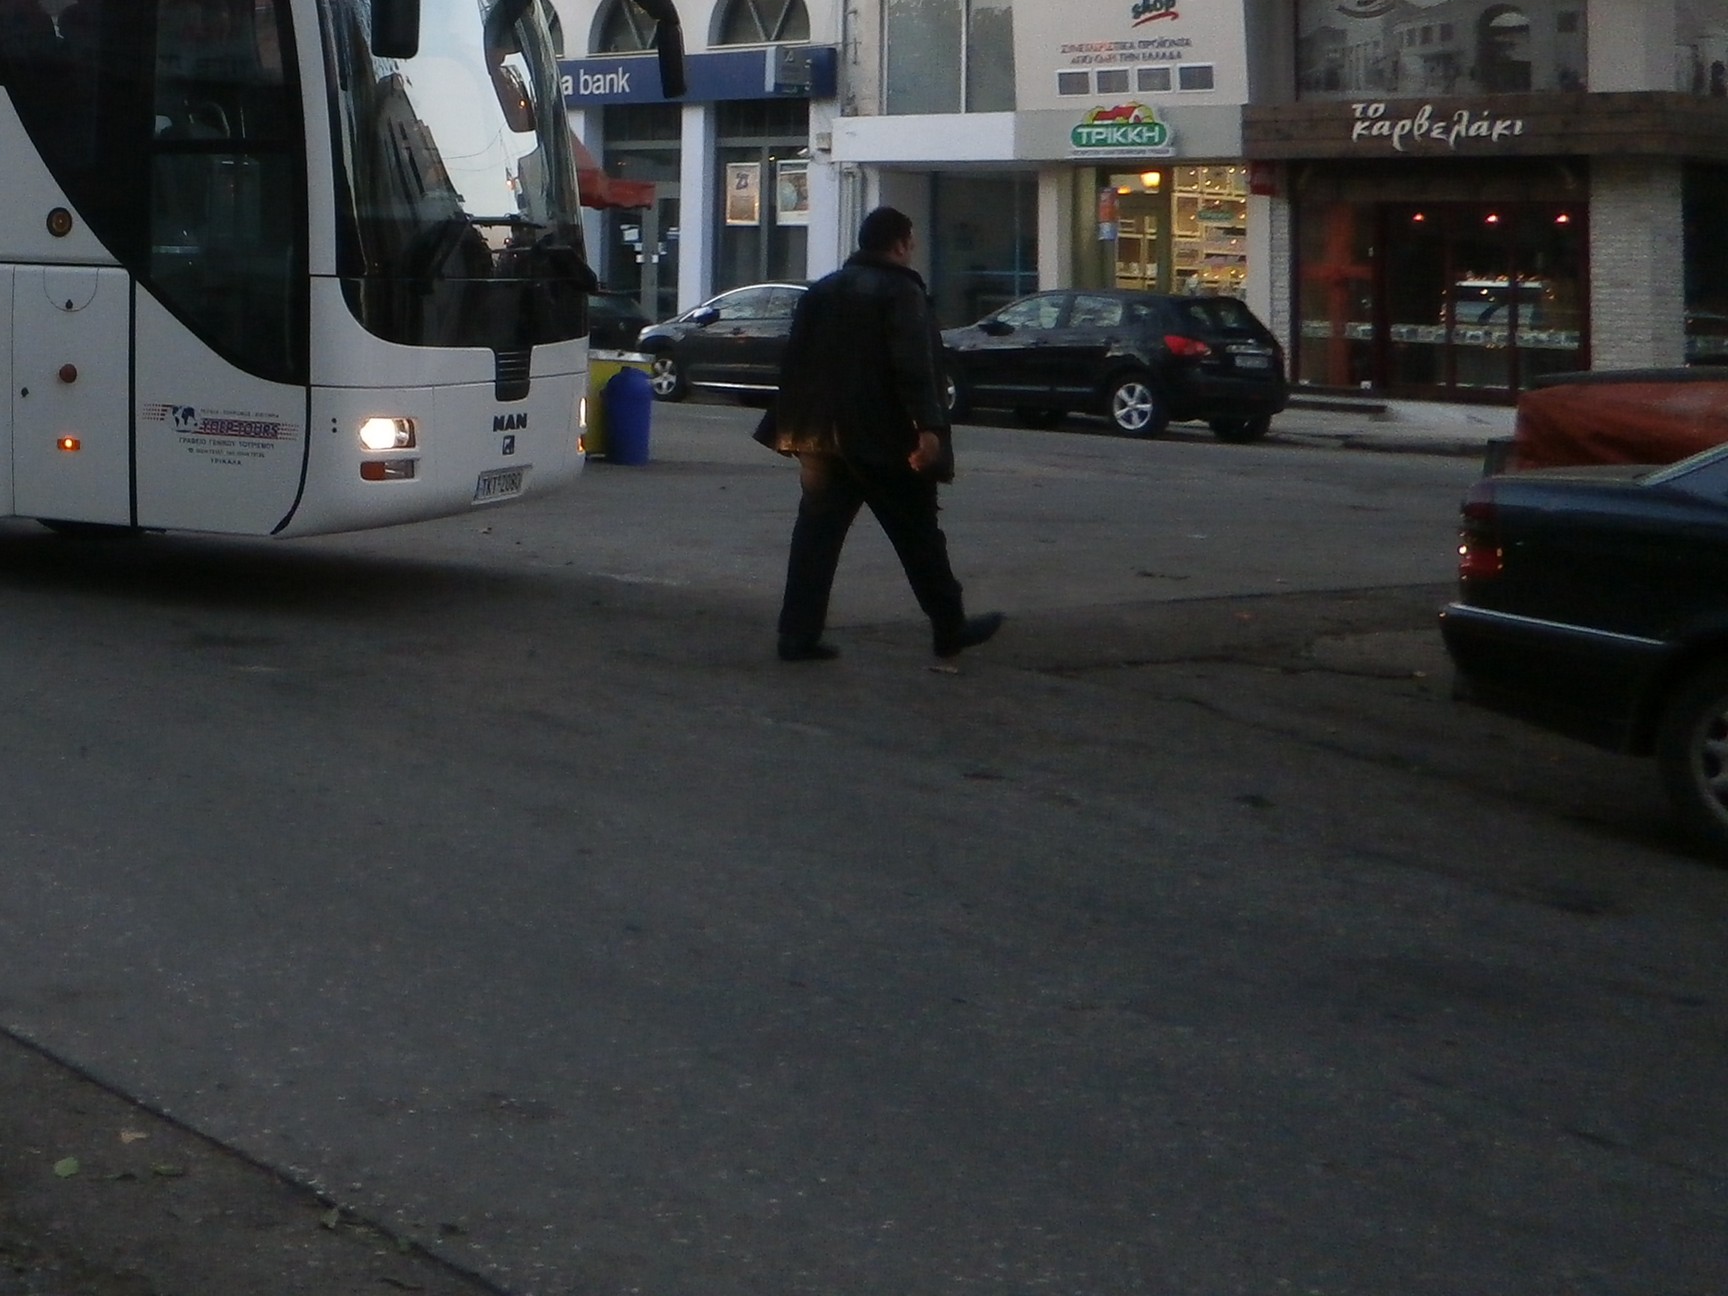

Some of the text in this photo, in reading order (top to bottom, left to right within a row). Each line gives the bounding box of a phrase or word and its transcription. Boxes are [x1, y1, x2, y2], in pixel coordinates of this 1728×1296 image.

[579, 66, 631, 95] bank
[1351, 103, 1386, 119] το
[1076, 126, 1160, 144] ΤΡΙΚΚΗ
[1351, 104, 1526, 152] καρβελάκι
[493, 413, 528, 432] MAN
